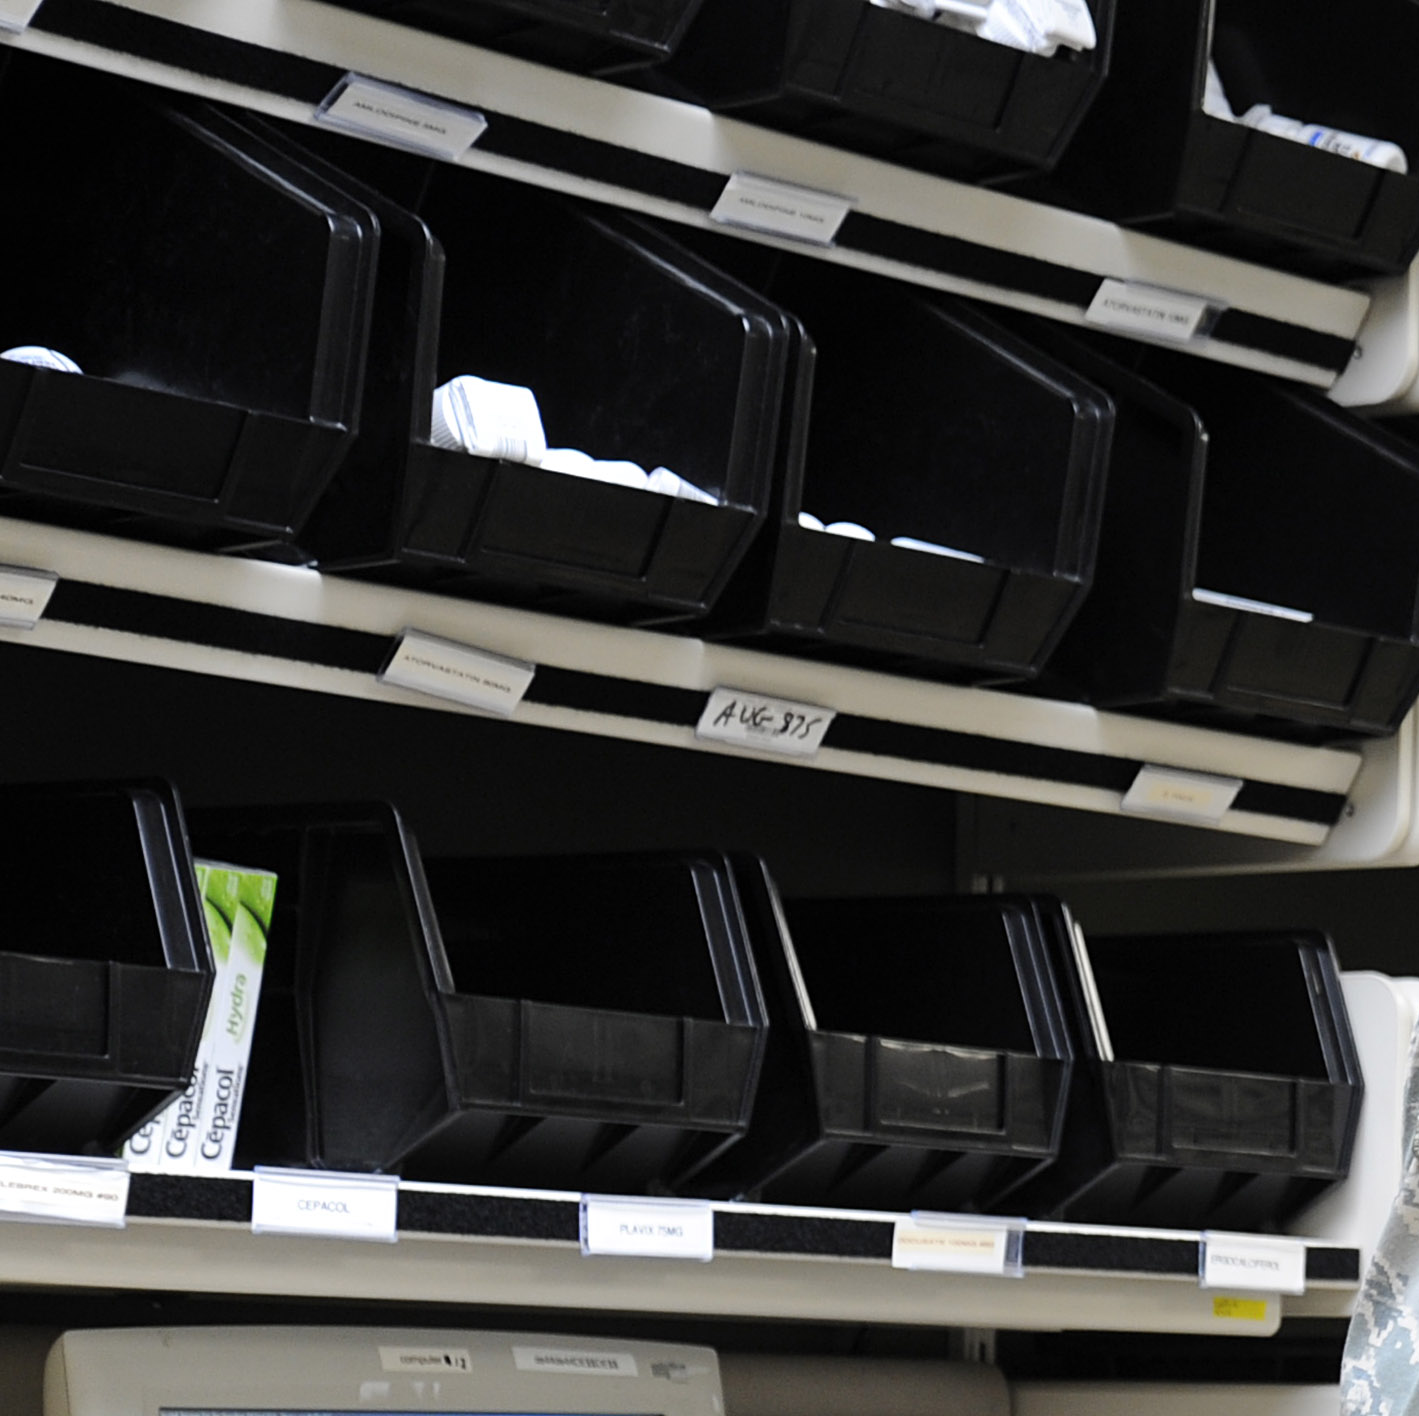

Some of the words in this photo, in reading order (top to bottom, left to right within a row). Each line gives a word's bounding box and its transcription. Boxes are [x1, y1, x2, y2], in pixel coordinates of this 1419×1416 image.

[404, 654, 481, 683] ATORVASTATIN
[780, 711, 823, 739] 875
[226, 973, 248, 1036] Hydra
[297, 1199, 350, 1213] CEPACOL
[620, 1224, 654, 1236] PLAVIX
